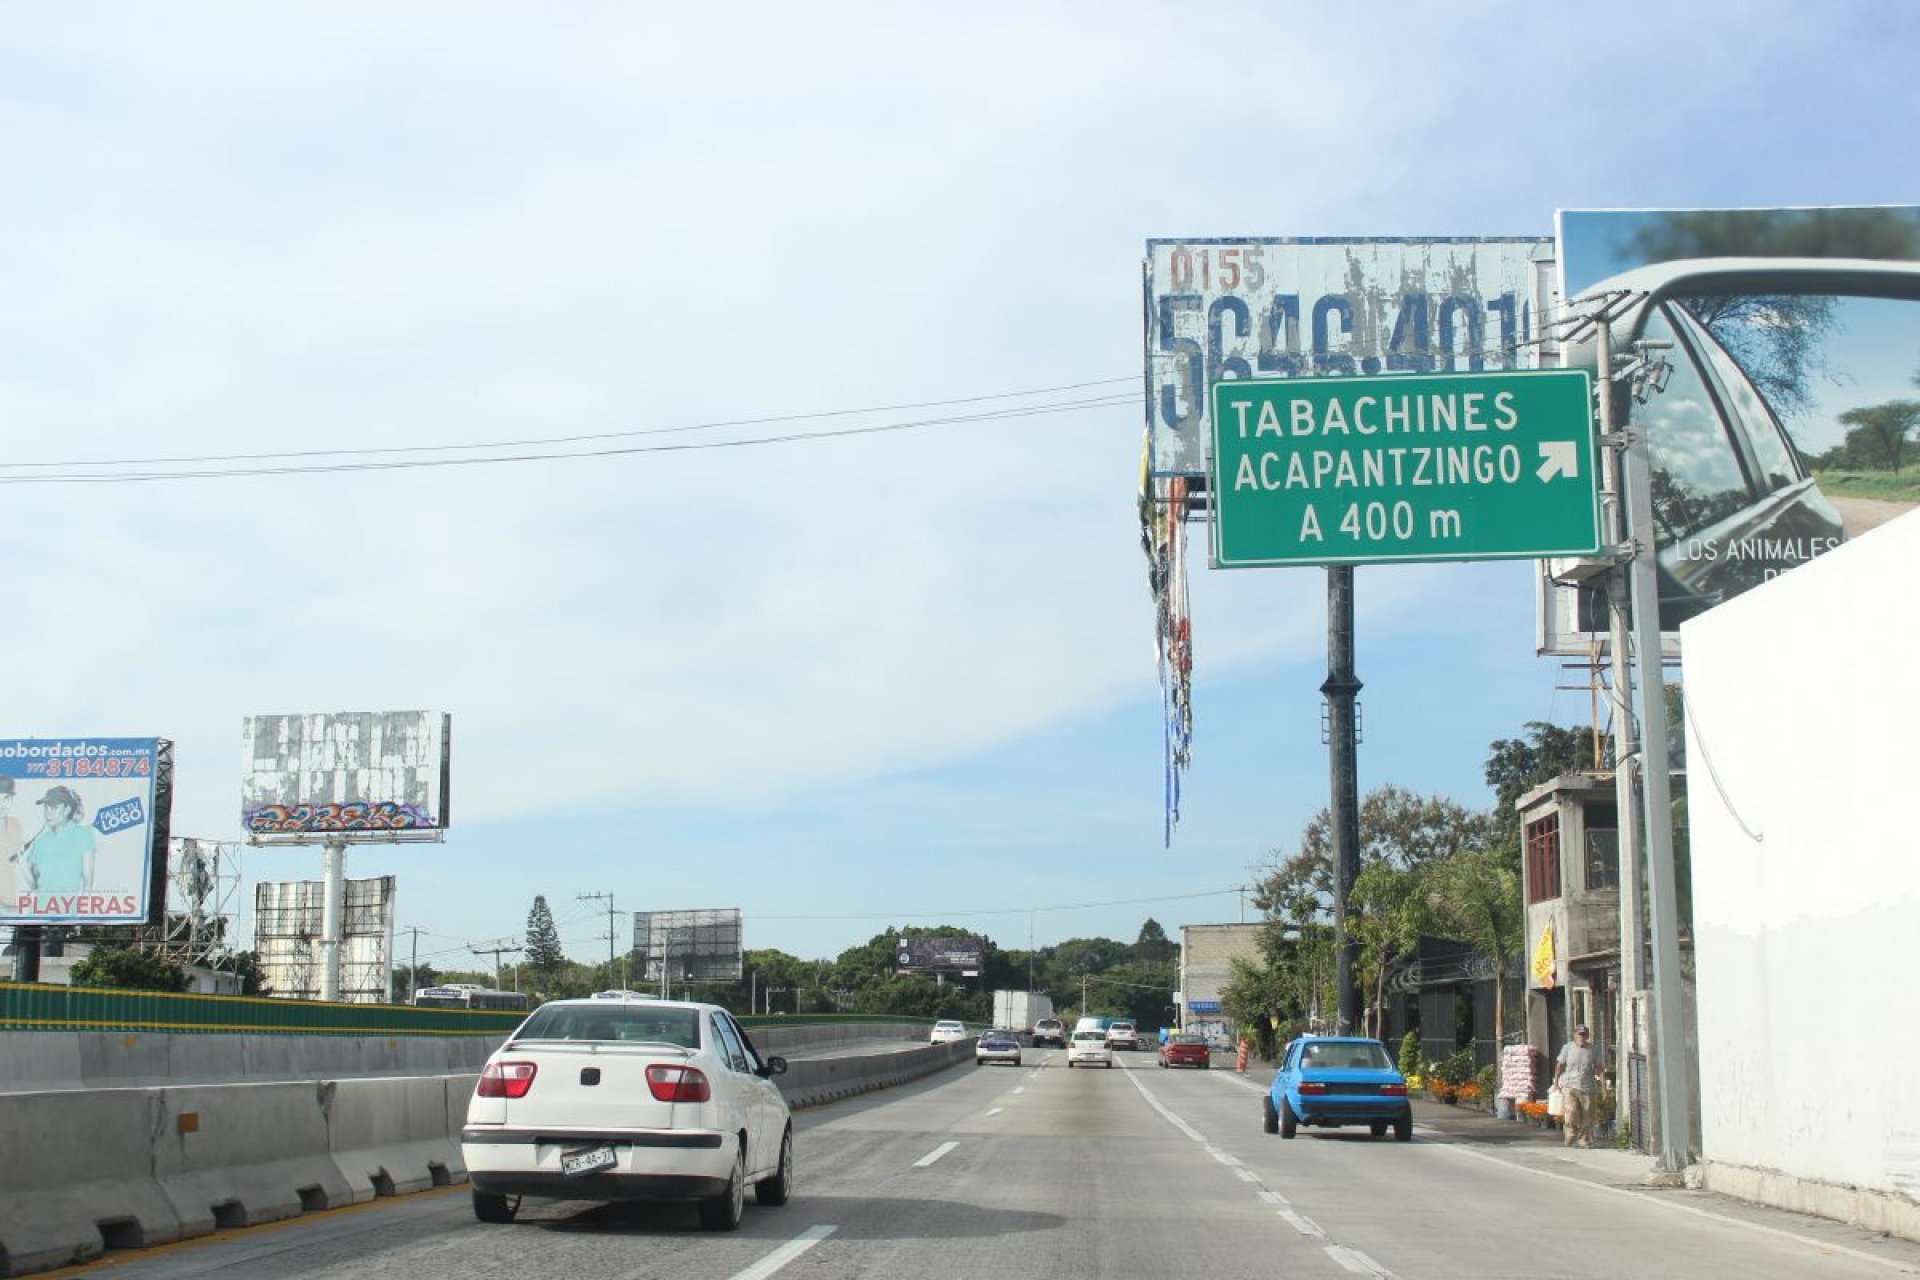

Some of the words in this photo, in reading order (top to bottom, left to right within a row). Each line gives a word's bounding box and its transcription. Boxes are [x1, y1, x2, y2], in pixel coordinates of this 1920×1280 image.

[1170, 249, 1265, 292] 0155
[1231, 392, 1518, 438] TABACHINES
[1234, 445, 1521, 491] ACAPANTZINGO
[1299, 504, 1323, 542] A
[1340, 501, 1414, 541] 400
[1429, 508, 1461, 538] m
[1676, 538, 1718, 561] LOS
[1725, 537, 1840, 561] ANIMALES
[100, 806, 126, 820] FALTA
[102, 809, 141, 831] LOGO
[18, 895, 136, 914] PLAYERAS
